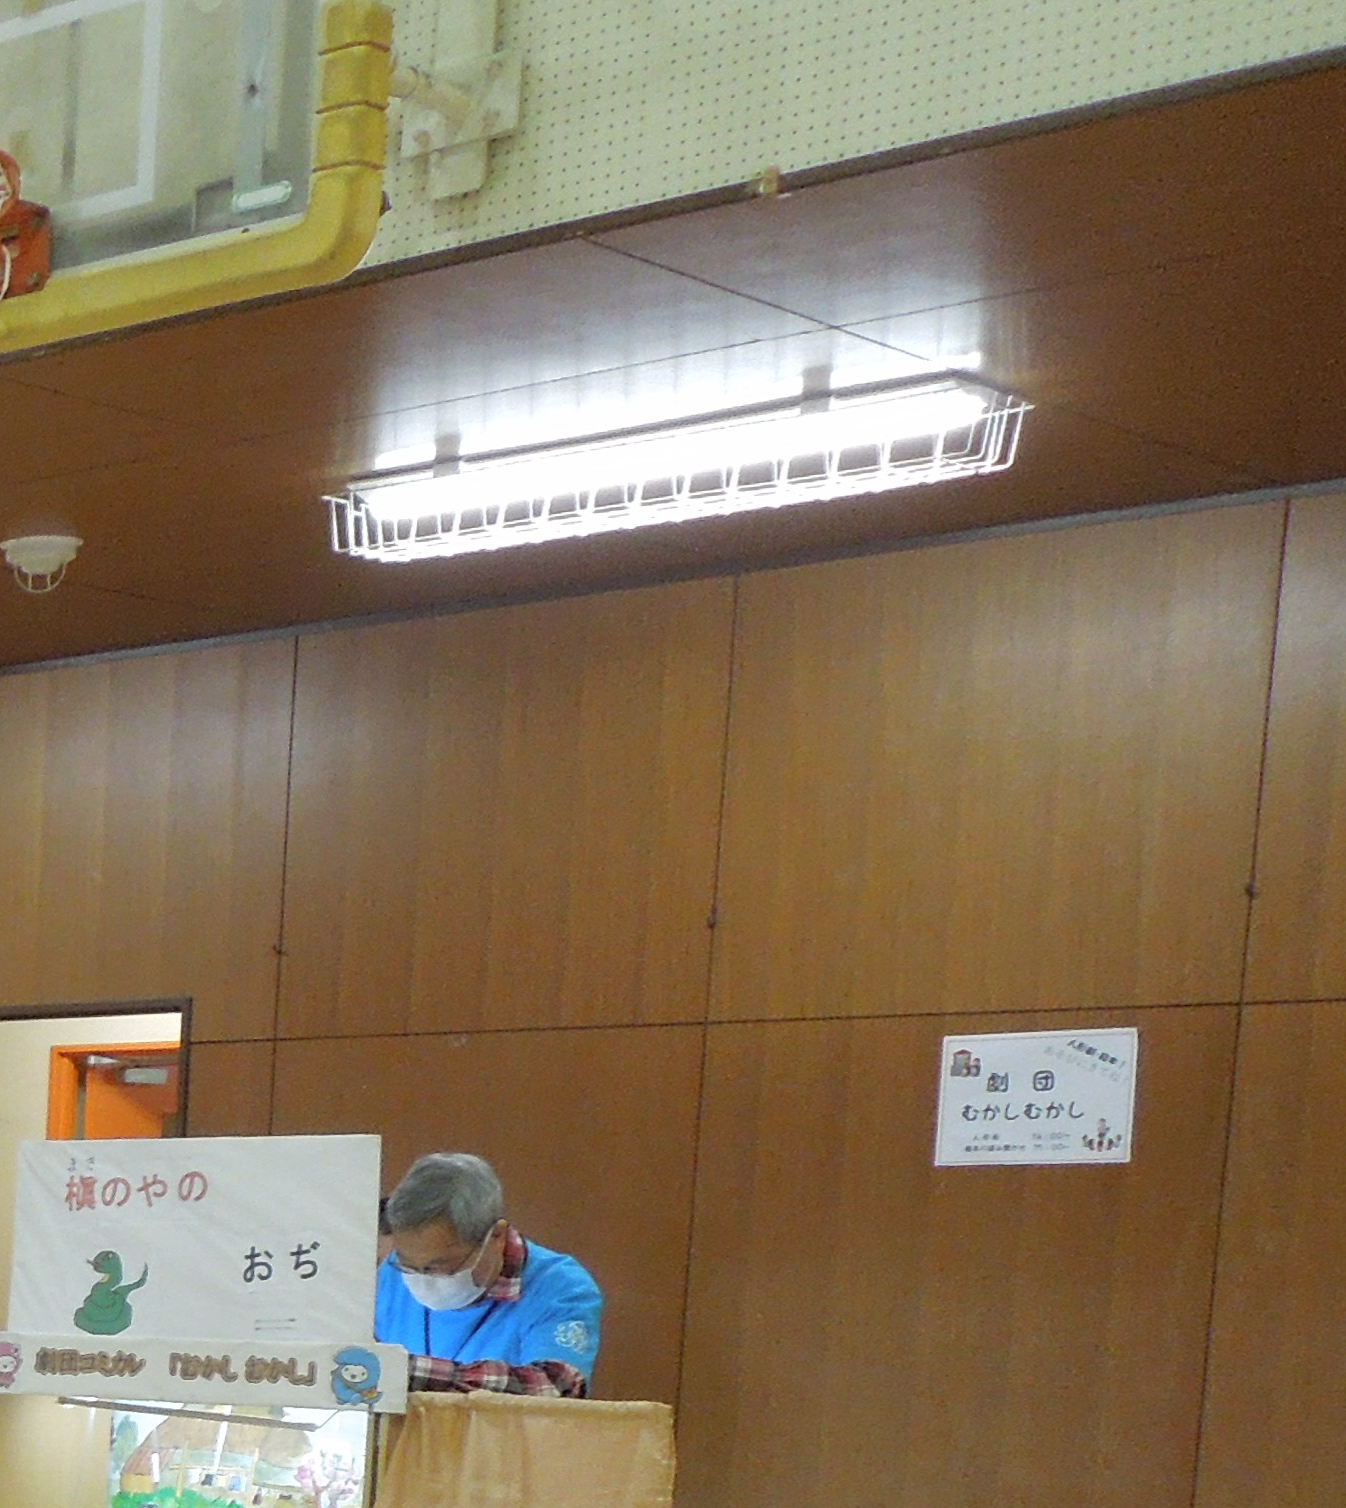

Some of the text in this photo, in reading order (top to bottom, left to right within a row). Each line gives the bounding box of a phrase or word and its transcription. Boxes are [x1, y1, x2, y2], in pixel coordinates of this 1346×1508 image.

[962, 1101, 1084, 1122] むかしむかし
